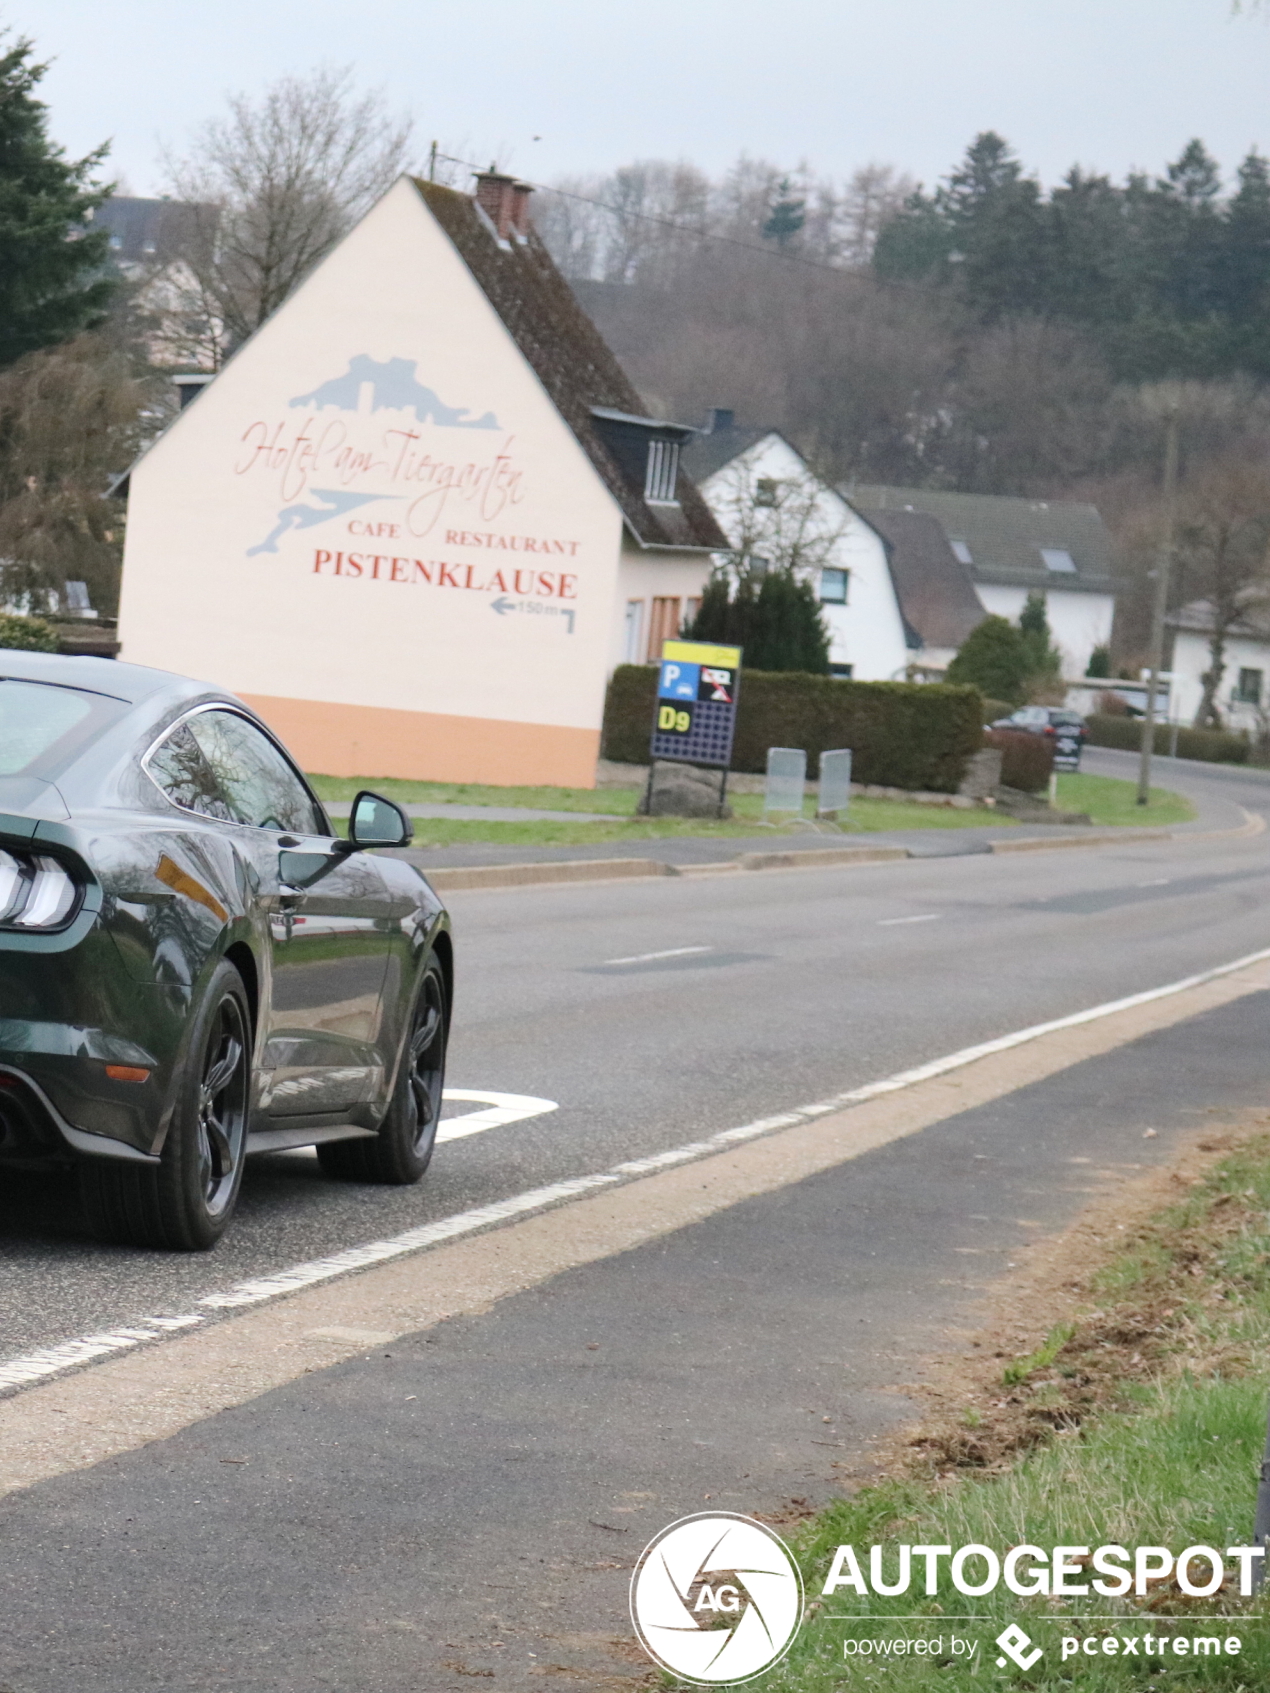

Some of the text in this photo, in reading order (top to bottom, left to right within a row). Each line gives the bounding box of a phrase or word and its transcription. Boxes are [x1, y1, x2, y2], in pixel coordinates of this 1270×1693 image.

[235, 416, 525, 538] Hotel am Tiergarten
[347, 520, 581, 557] CAFE RESTAURANT
[312, 549, 578, 599] PISTENKLAUSE
[663, 664, 681, 688] P
[658, 706, 691, 732] D9
